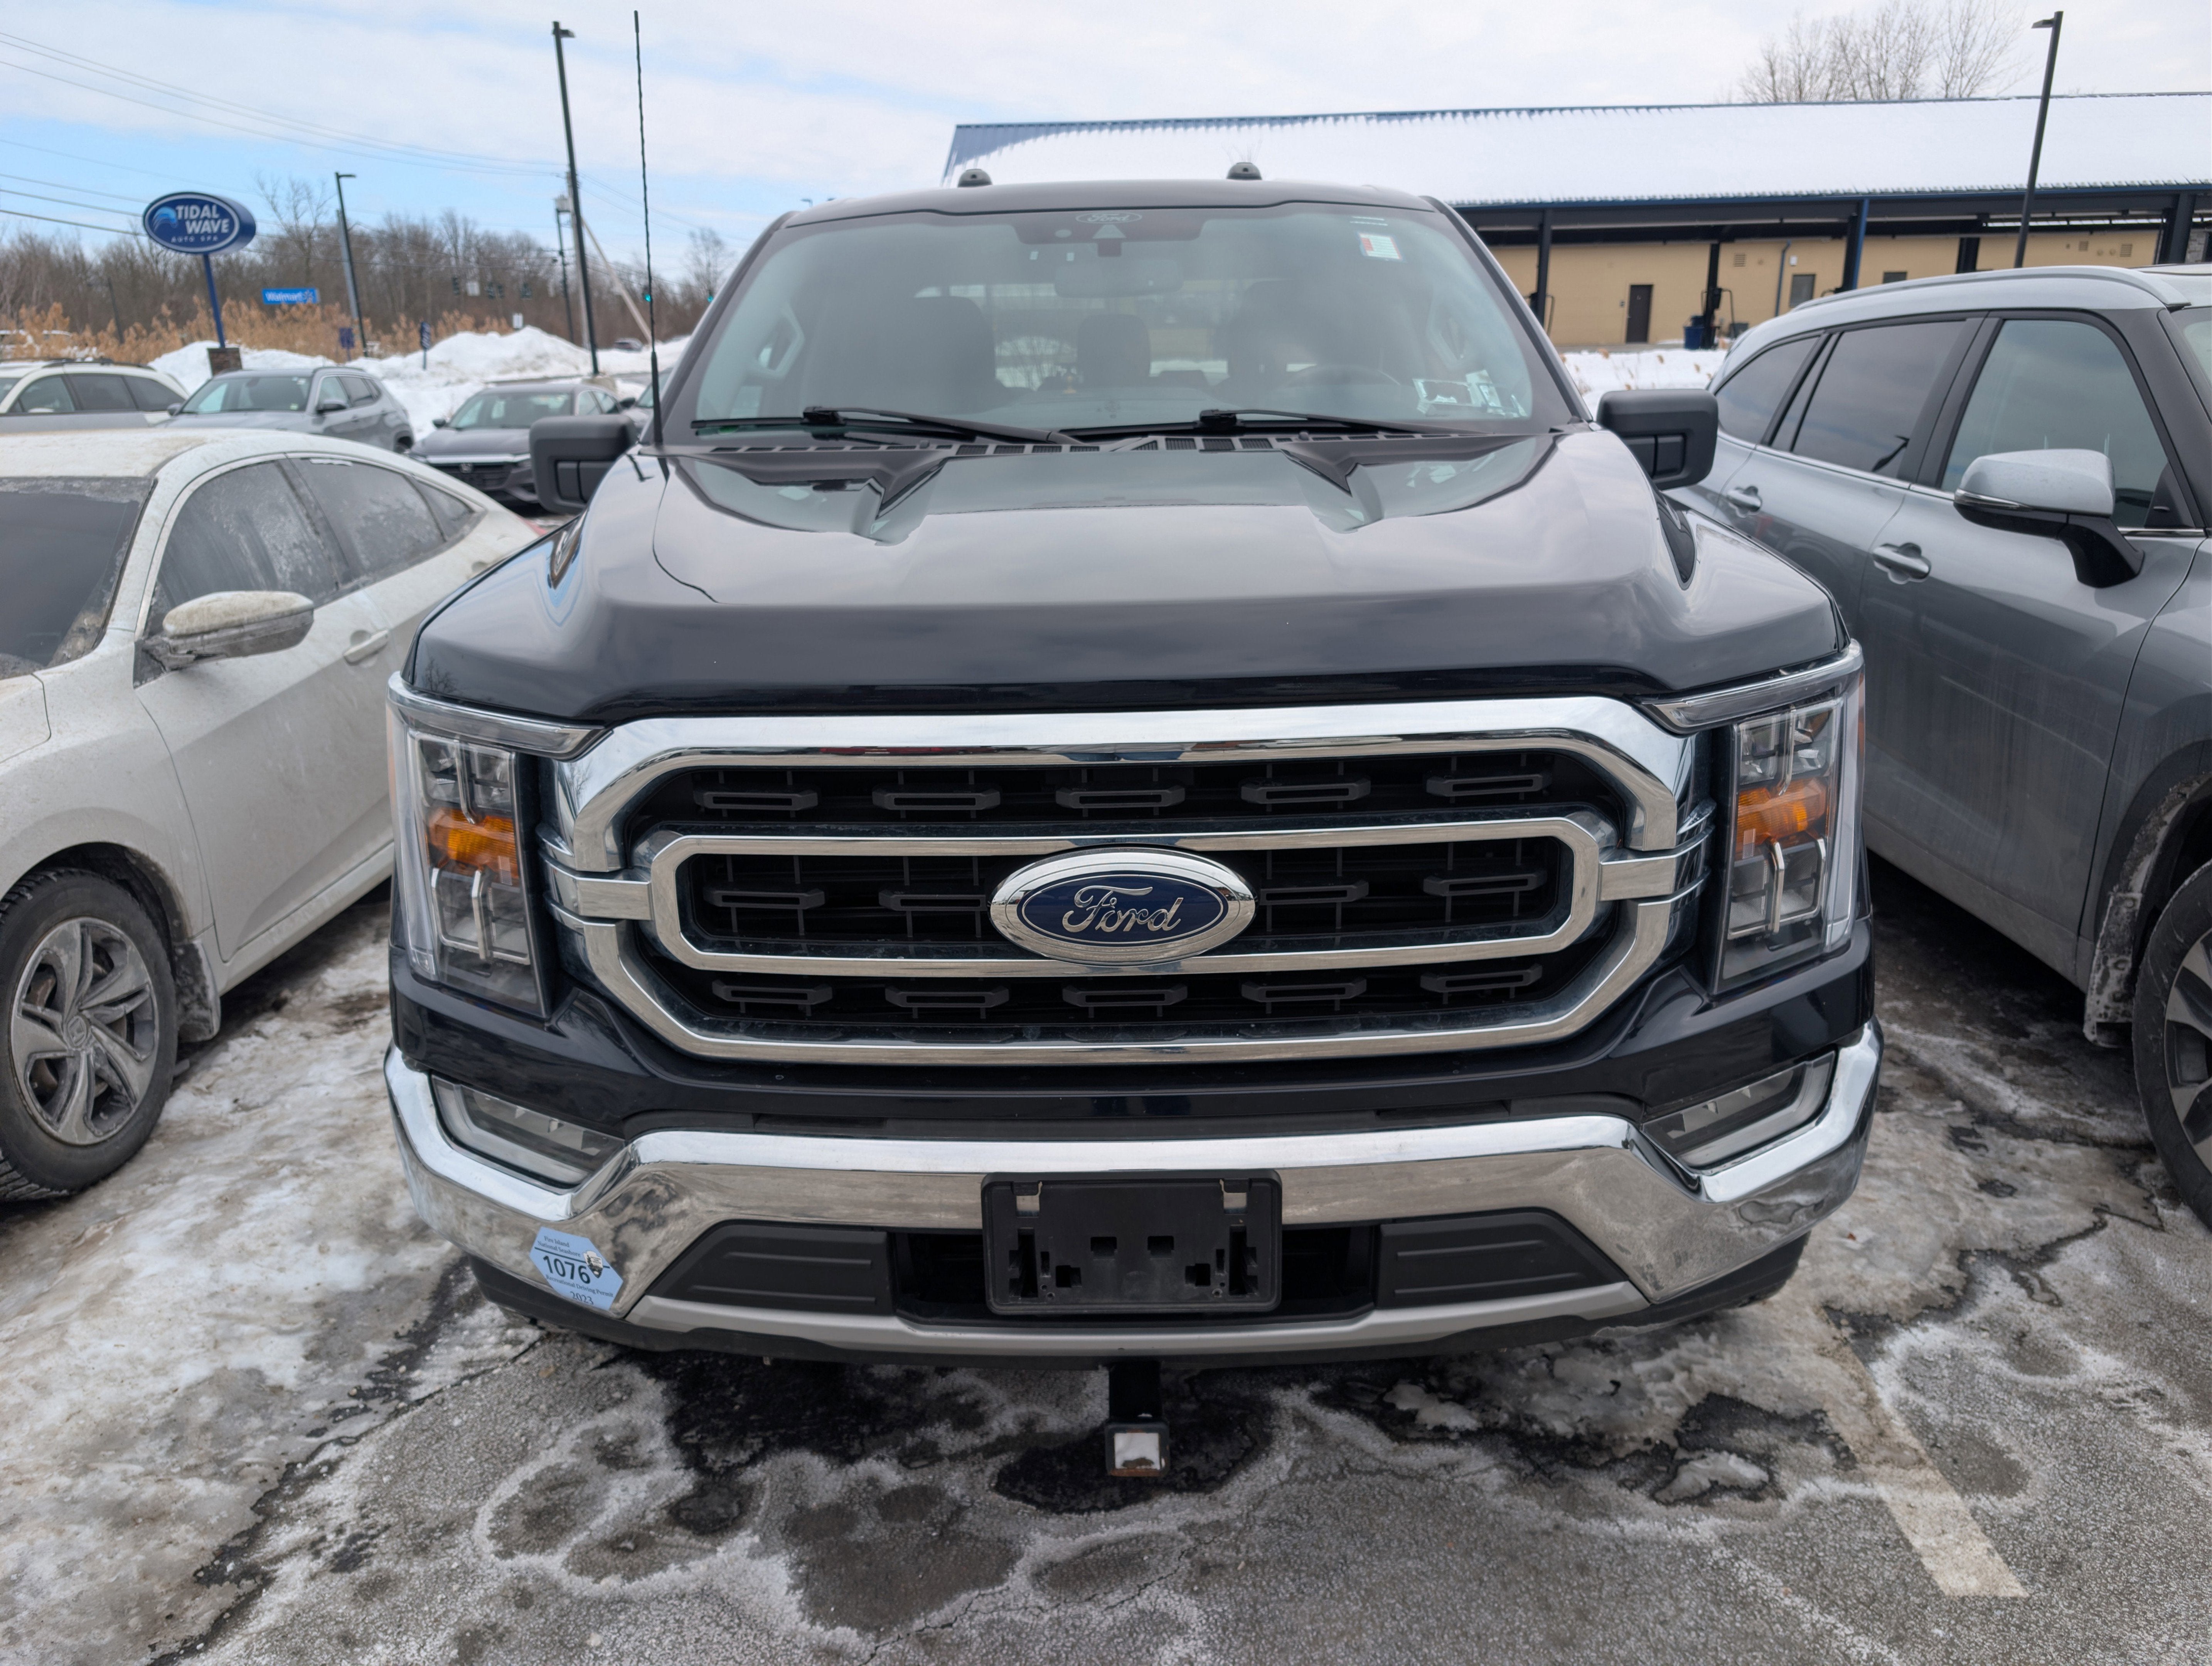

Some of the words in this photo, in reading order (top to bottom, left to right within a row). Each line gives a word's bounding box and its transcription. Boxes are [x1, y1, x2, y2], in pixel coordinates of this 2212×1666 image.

[175, 204, 220, 220] TIDAL
[1087, 213, 1130, 221] Ford
[185, 218, 230, 234] WAVE
[265, 292, 302, 301] Walmart
[1062, 885, 1184, 932] Ford
[537, 1241, 558, 1250] National
[559, 1248, 581, 1257] Seashore
[554, 1239, 569, 1248] Island
[543, 1256, 590, 1284] 1076
[546, 1275, 576, 1287] Recreational
[576, 1283, 596, 1294] Driving
[596, 1289, 614, 1298] Permit
[570, 1292, 594, 1305] 2023
